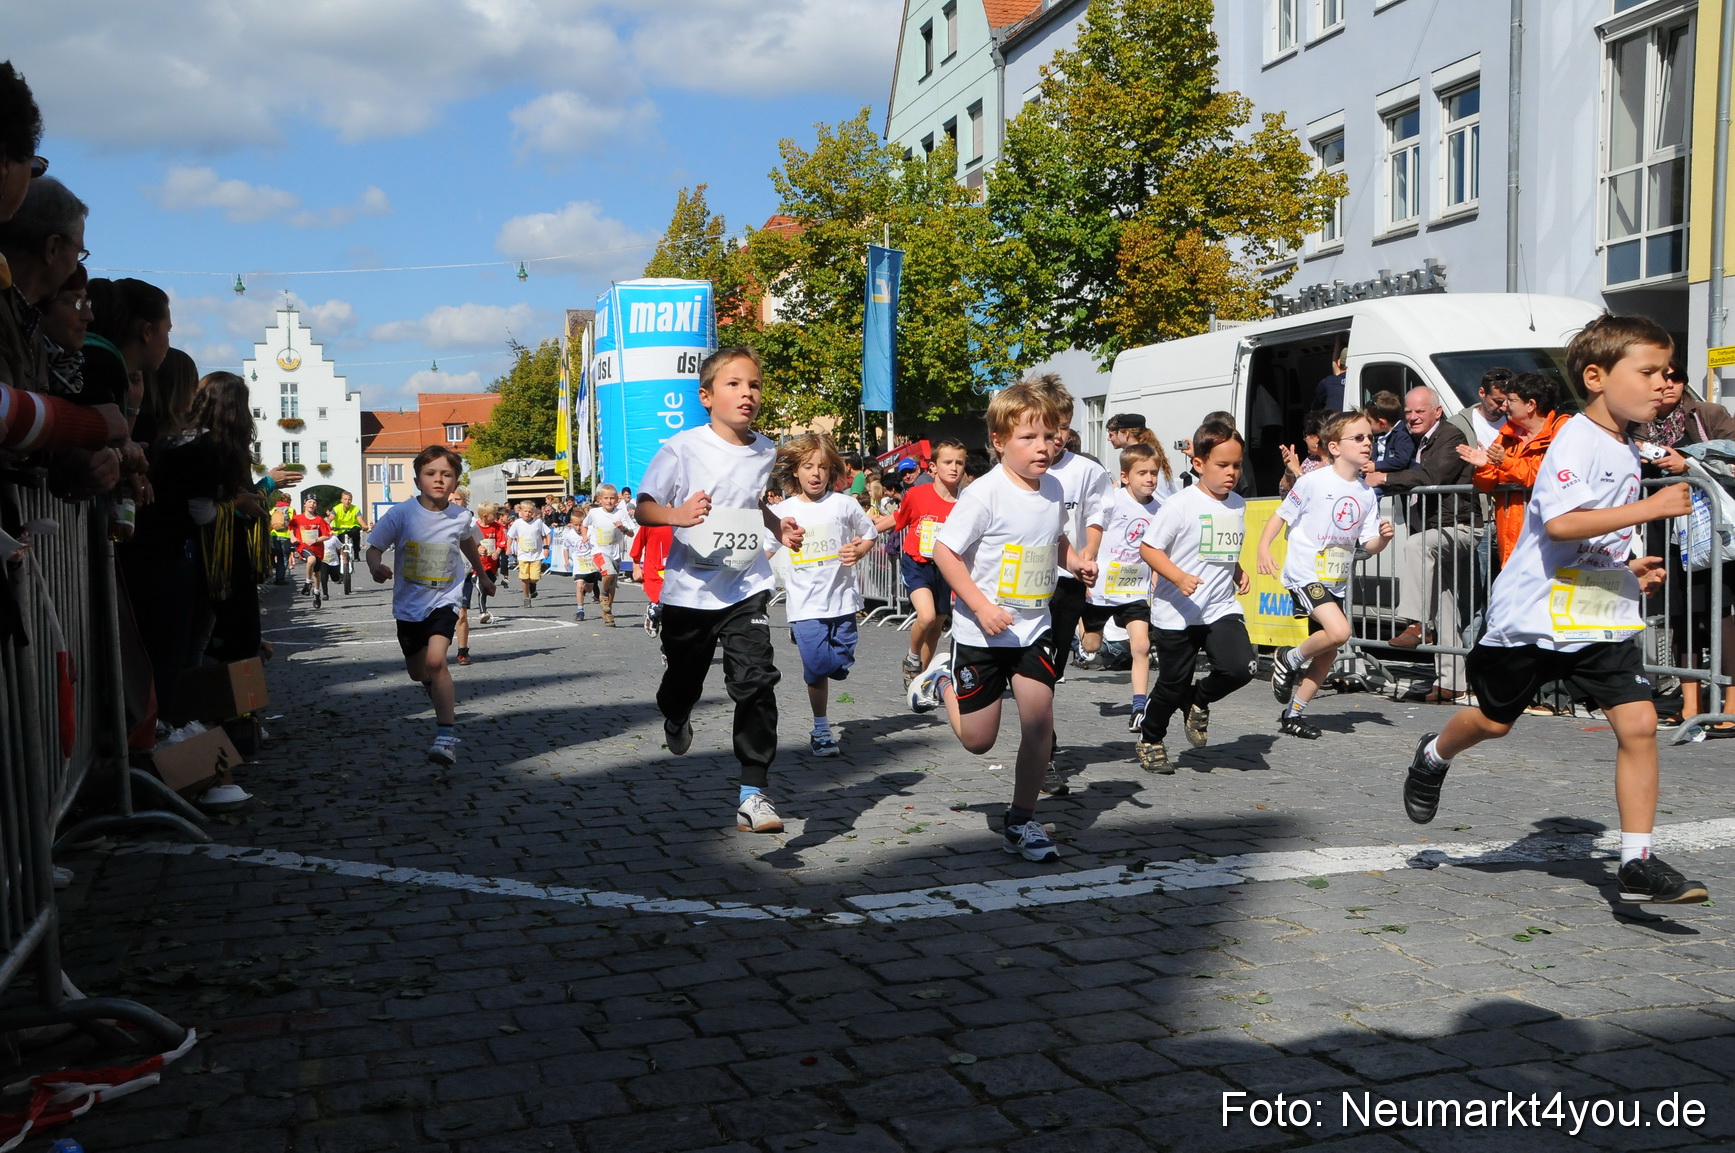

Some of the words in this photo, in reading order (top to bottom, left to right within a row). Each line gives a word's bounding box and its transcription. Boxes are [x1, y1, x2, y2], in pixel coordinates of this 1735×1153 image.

[629, 295, 702, 334] maxi
[676, 351, 701, 374] dsl
[713, 532, 758, 550] 7323
[804, 538, 837, 554] 7283
[1217, 532, 1244, 546] 7302
[1025, 551, 1045, 563] Elias
[1328, 562, 1350, 574] 7105
[1024, 568, 1056, 588] 7050
[1117, 577, 1143, 587] 7287
[1553, 596, 1566, 607] K4
[1578, 599, 1633, 620] 7102
